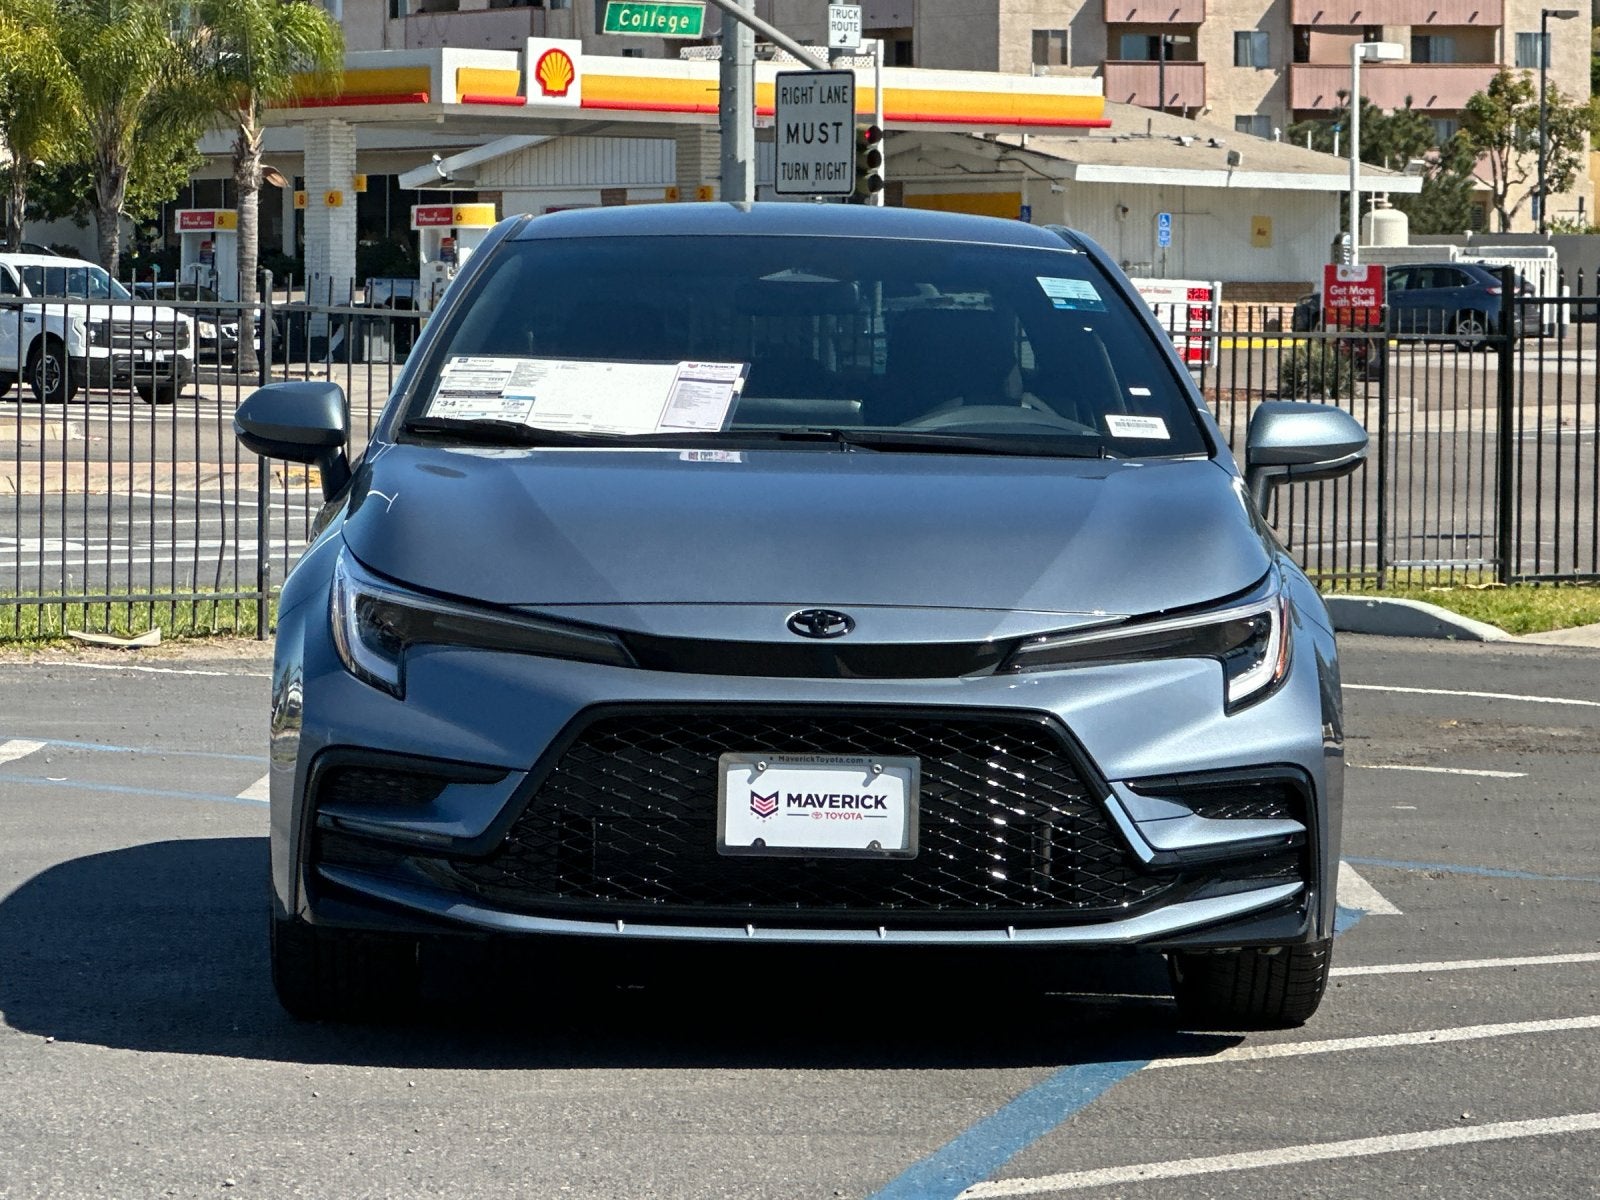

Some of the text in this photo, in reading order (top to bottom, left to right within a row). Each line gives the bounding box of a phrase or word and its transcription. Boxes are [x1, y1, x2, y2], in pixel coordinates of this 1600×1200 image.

[831, 8, 858, 19] TRUCK
[619, 9, 690, 33] College
[831, 21, 858, 32] ROUTE
[781, 85, 848, 105] RIGHT LANE
[786, 121, 843, 145] MUST
[781, 162, 847, 181] TURN RIGHT
[328, 193, 335, 204] 6
[700, 189, 706, 199] 2
[298, 195, 304, 205] 8
[218, 216, 224, 225] 8
[456, 212, 463, 221] 6
[1330, 285, 1375, 295] Get More
[1330, 296, 1375, 307] with Shell
[778, 755, 864, 764] MaverickToyota.com
[786, 793, 888, 810] MAVERICK
[824, 811, 863, 821] TOYOTA
